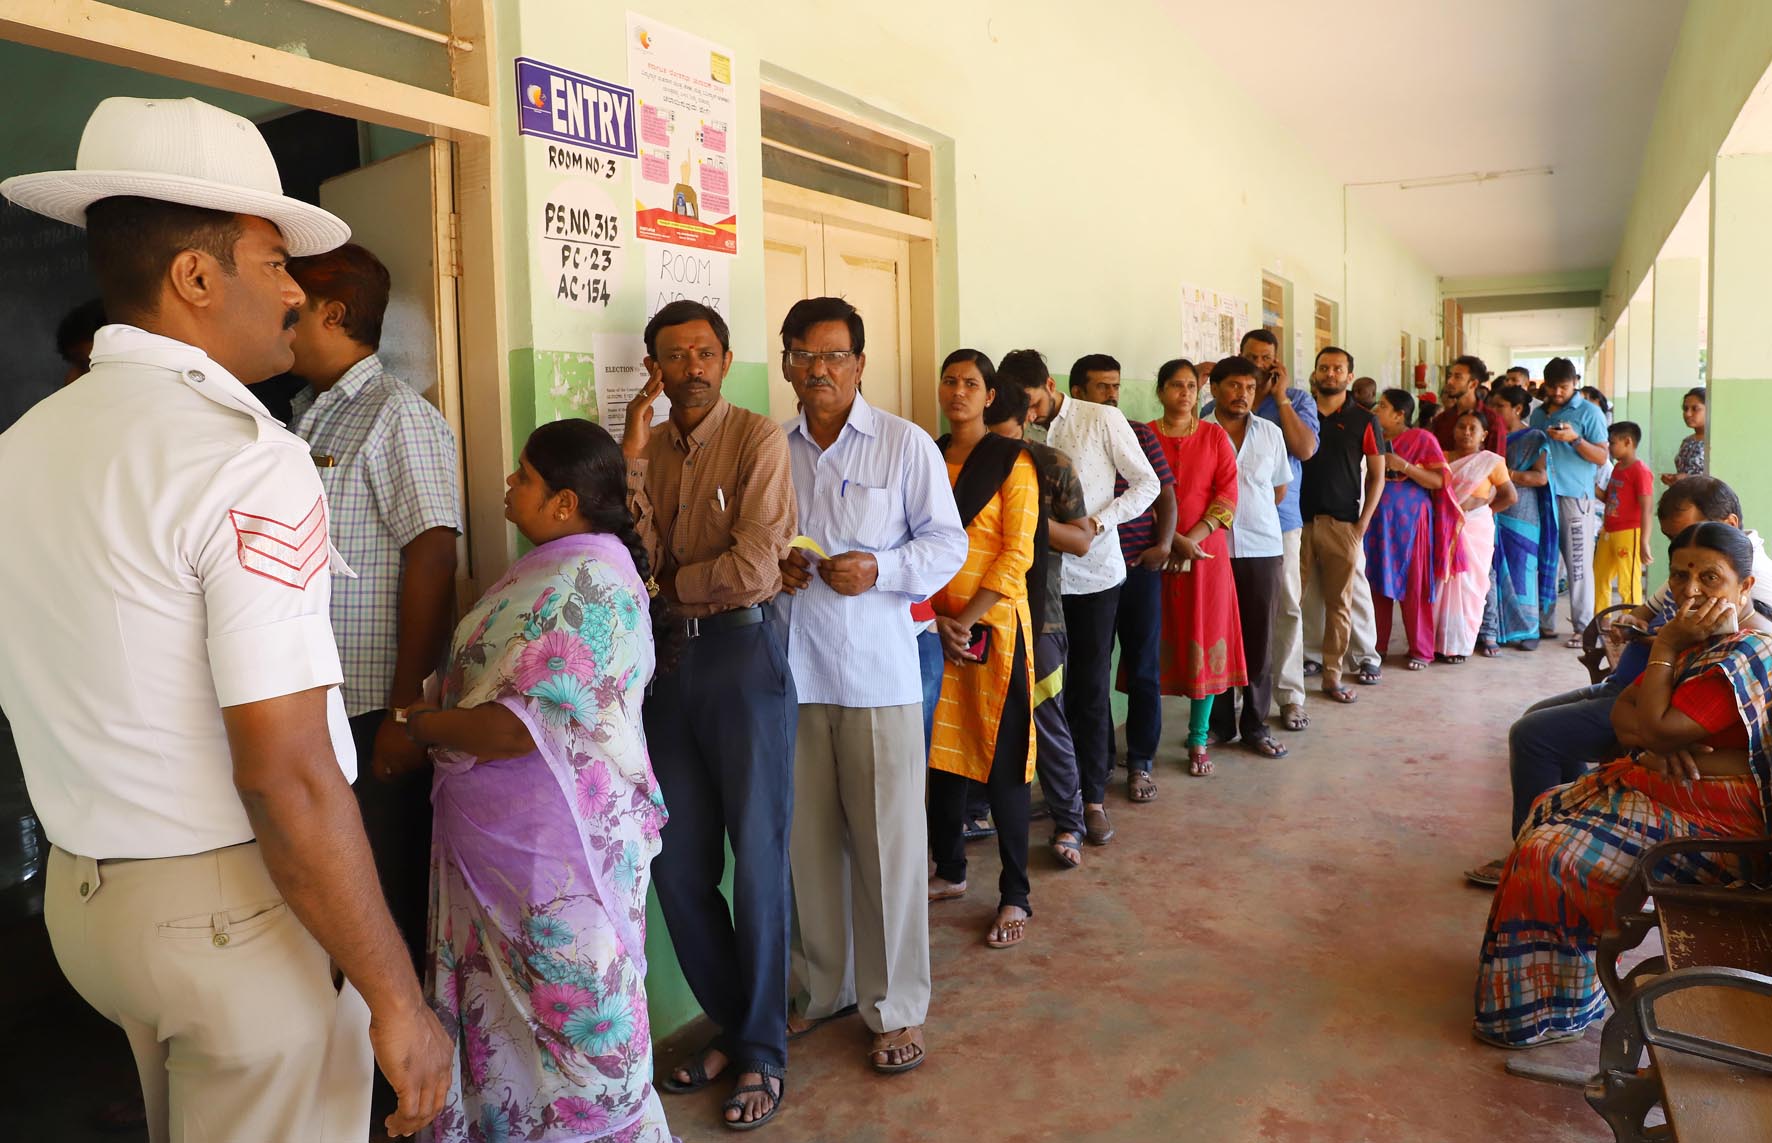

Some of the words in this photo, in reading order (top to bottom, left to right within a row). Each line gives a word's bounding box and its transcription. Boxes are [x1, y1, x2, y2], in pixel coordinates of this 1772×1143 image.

[550, 75, 628, 147] ENTRY
[548, 145, 583, 170] ROOM
[660, 249, 711, 286] ROOM
[1571, 524, 1584, 582] WINNER
